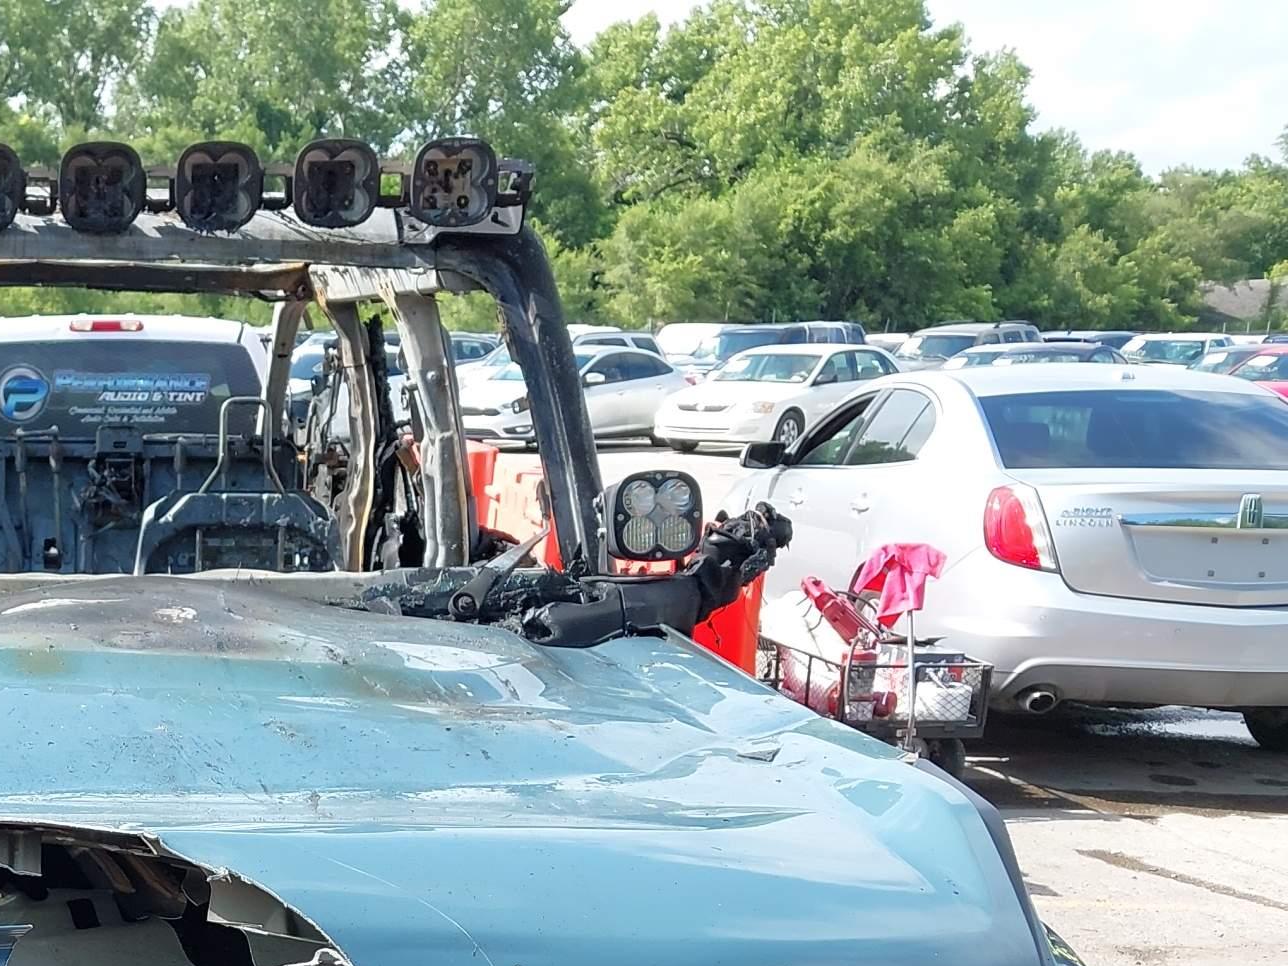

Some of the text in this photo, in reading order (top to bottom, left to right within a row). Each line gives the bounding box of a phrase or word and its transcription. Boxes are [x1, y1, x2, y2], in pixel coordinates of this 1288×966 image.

[98, 391, 149, 402] AUDIO
[168, 391, 206, 402] TINT
[1056, 519, 1113, 528] LINCOLN
